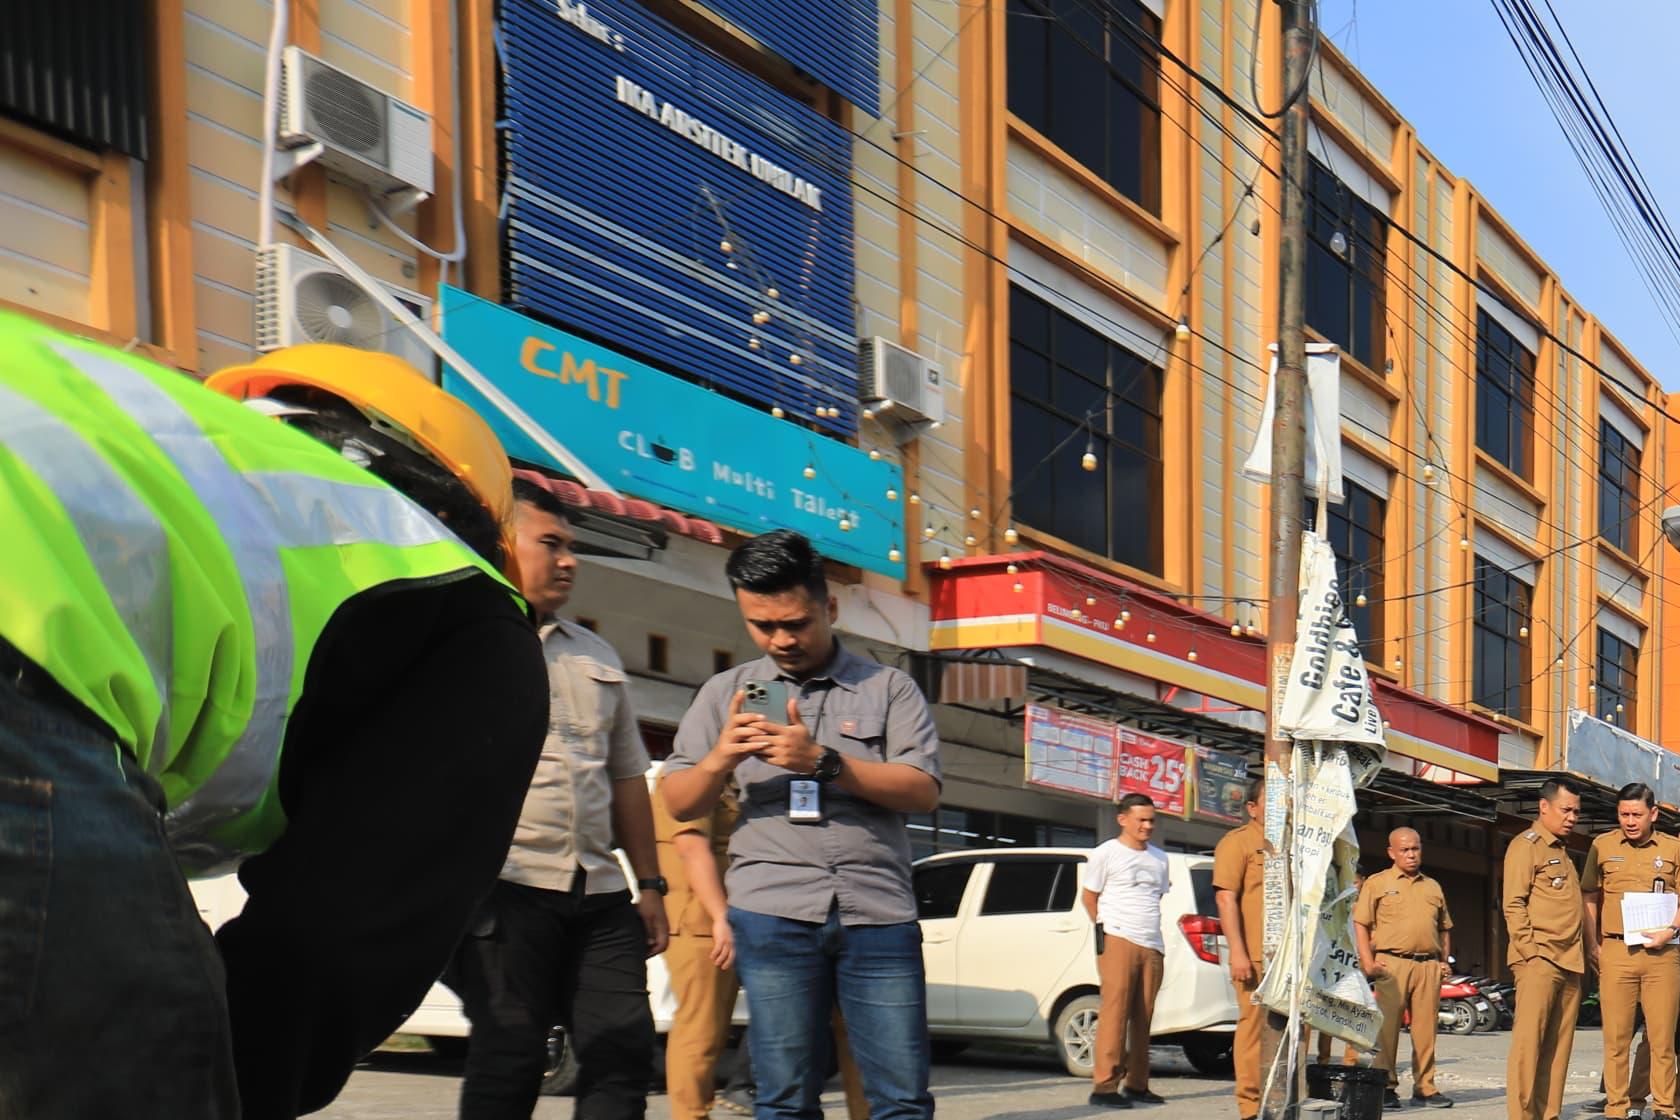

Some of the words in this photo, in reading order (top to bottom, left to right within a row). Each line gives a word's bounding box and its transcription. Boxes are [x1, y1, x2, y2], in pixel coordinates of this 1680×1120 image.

[519, 335, 630, 410] CMT
[712, 461, 777, 501] Multi
[1332, 664, 1363, 724] Cafe
[1119, 752, 1149, 770] CASH
[1119, 764, 1149, 782] BACK
